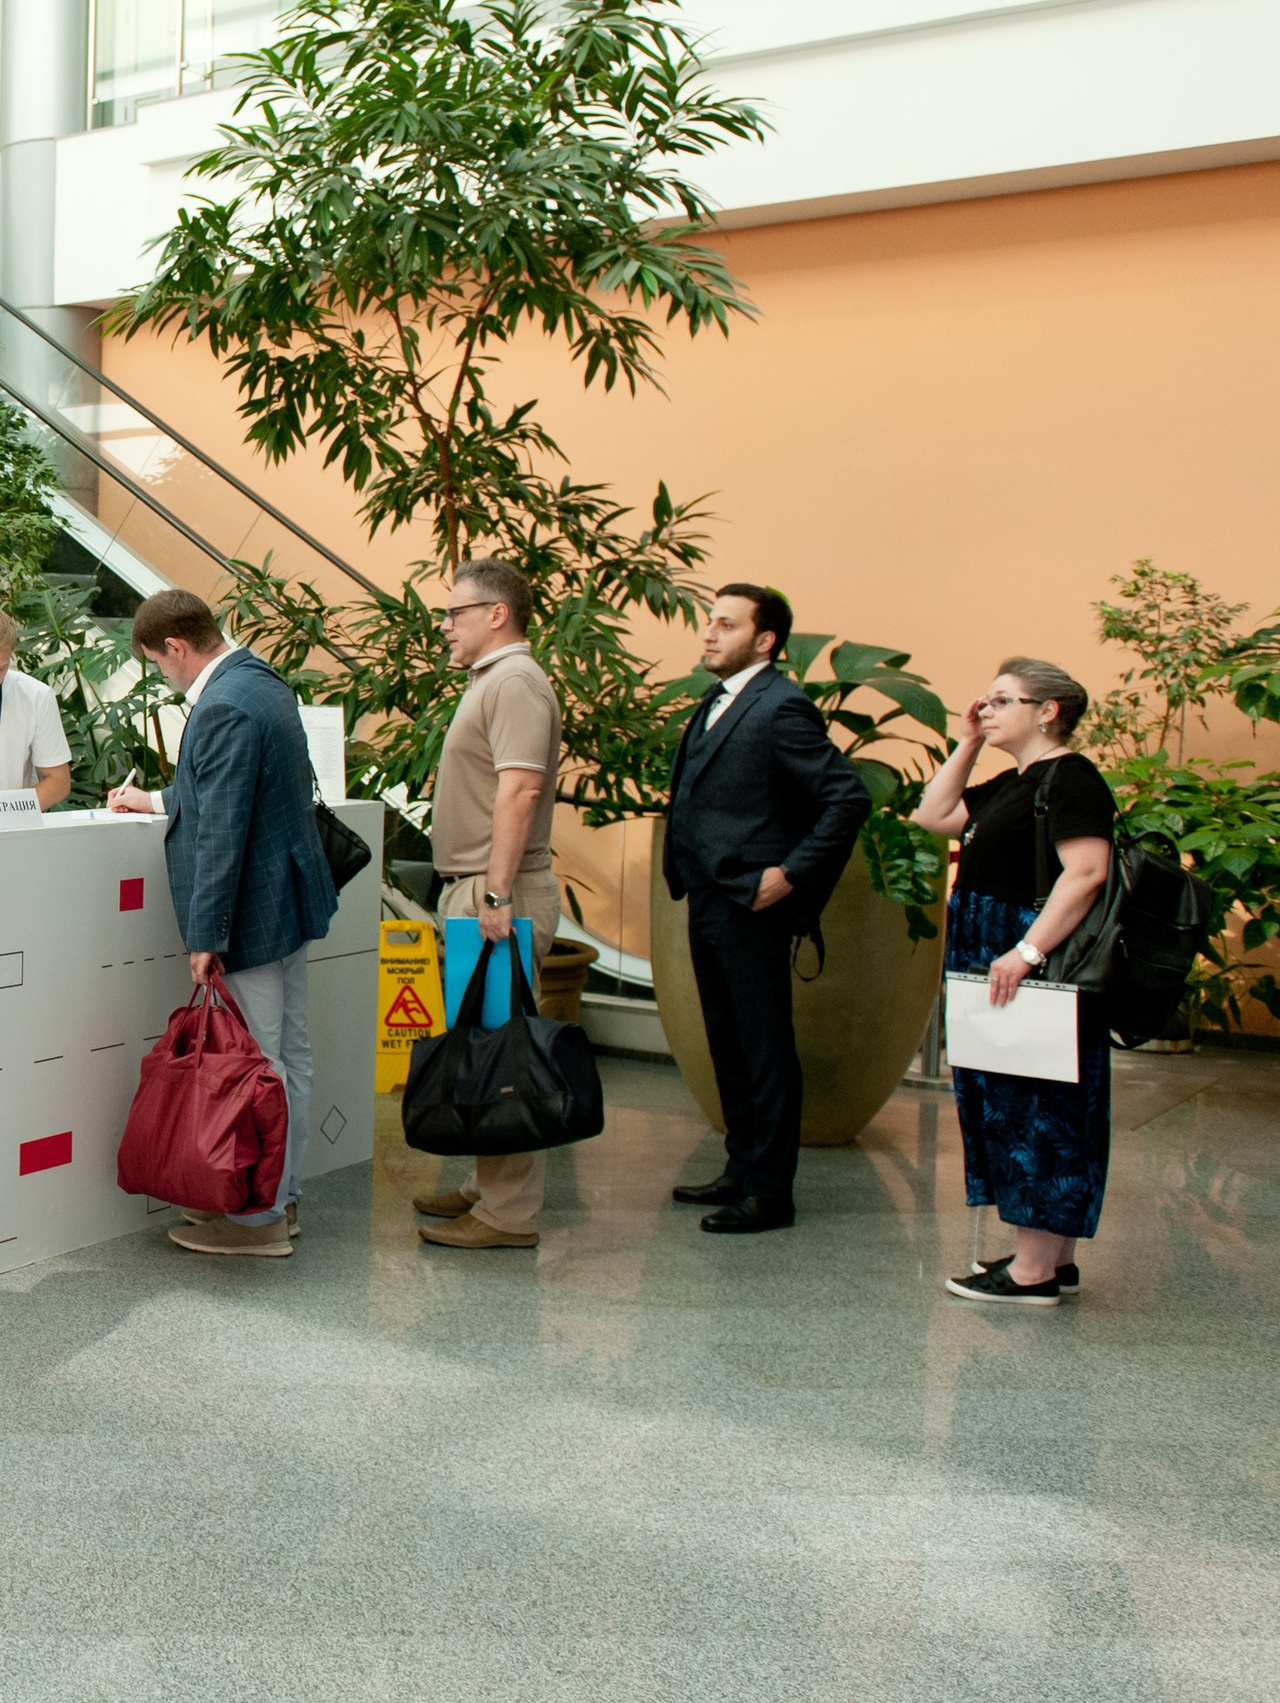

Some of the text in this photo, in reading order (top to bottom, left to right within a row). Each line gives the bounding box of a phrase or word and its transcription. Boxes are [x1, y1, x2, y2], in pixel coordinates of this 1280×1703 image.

[387, 966, 425, 975] МОКРЫЙ
[397, 976, 416, 984] ПОЛ
[387, 1028, 431, 1038] CAUTION
[381, 1039, 402, 1049] WET
